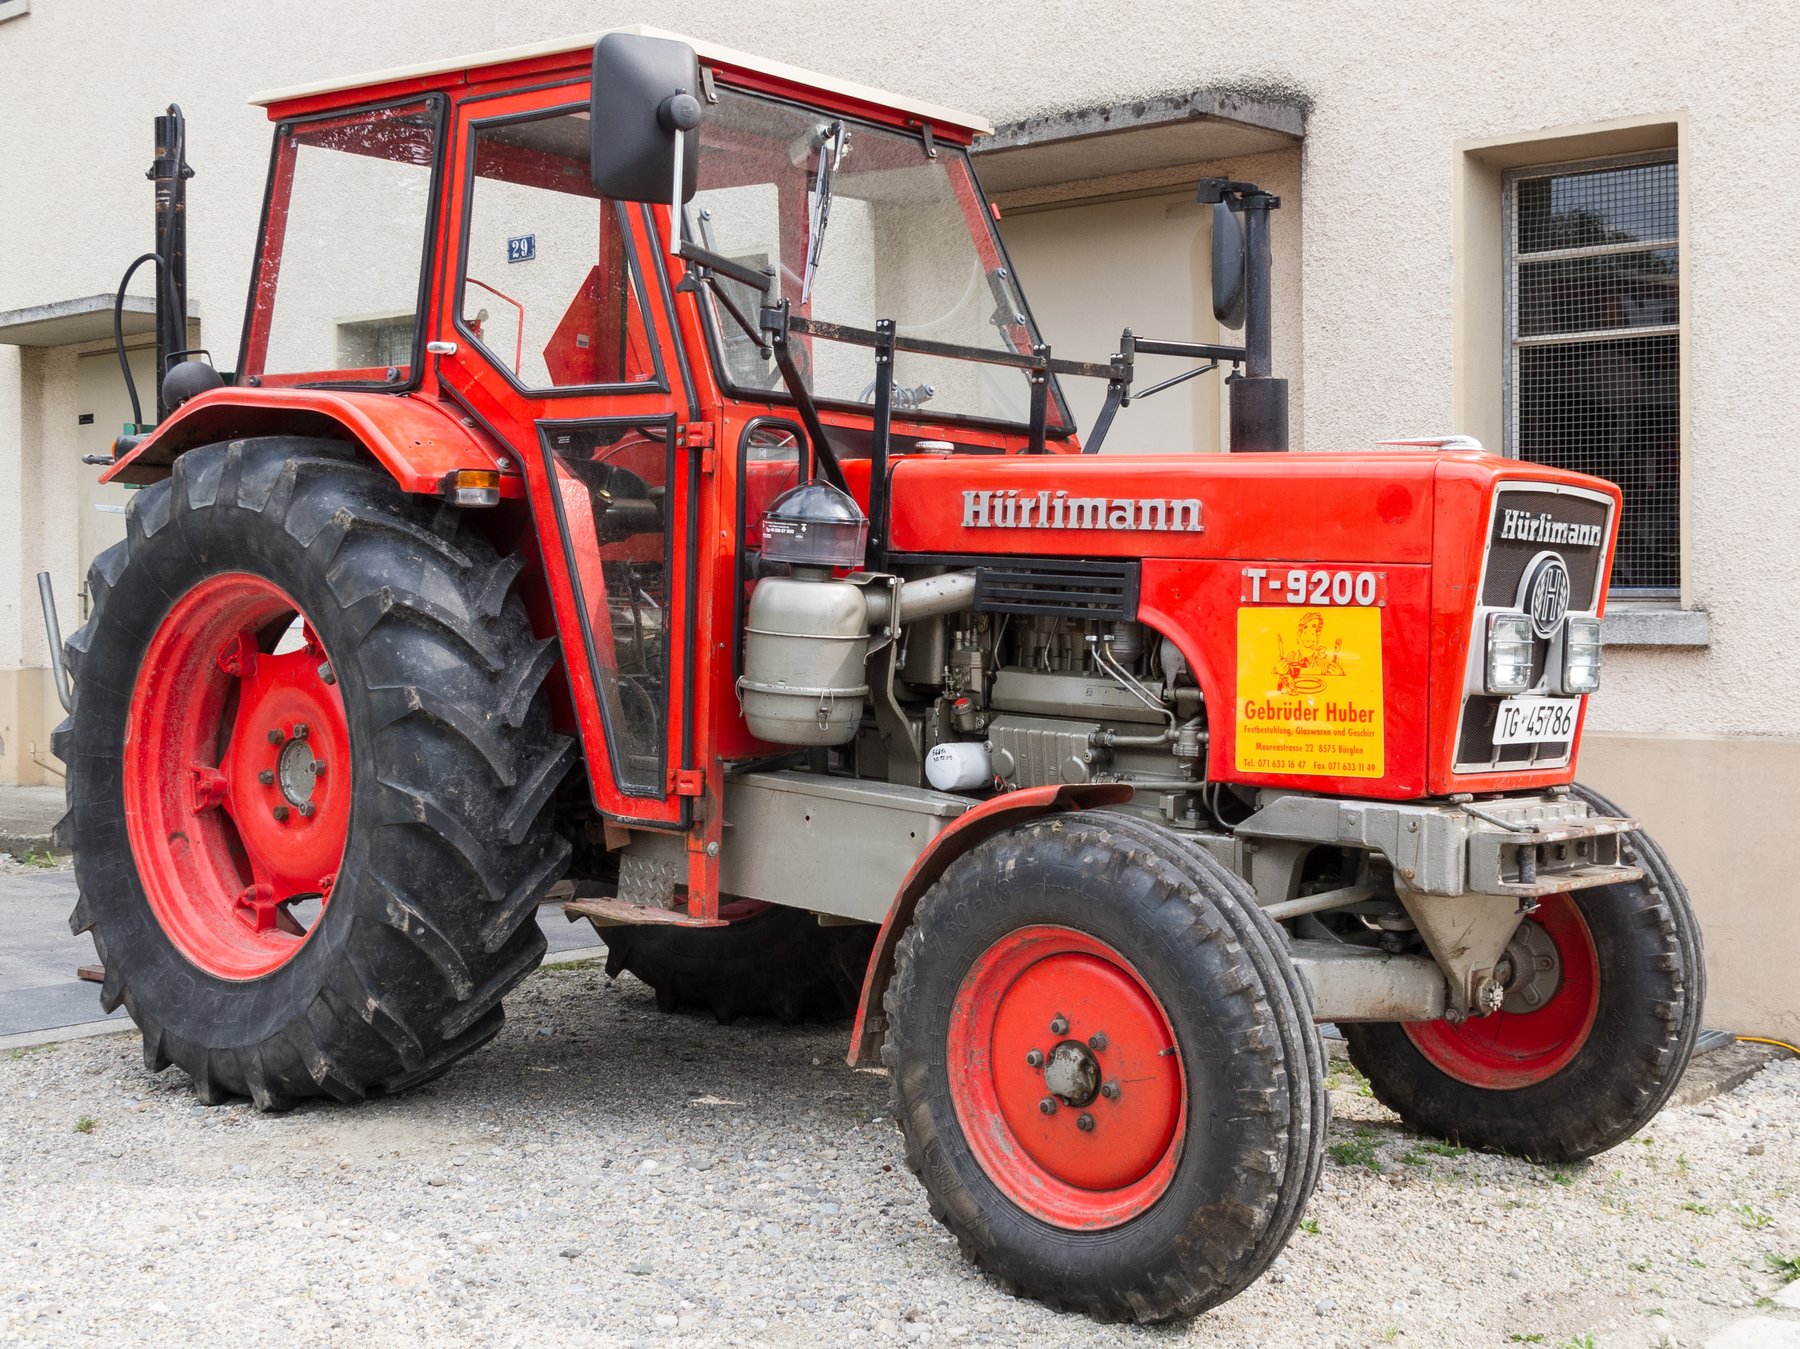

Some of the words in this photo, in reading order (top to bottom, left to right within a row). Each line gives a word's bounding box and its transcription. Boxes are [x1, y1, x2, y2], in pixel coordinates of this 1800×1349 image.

[512, 239, 528, 258] 29
[961, 489, 1204, 532] Hürlimann
[1500, 509, 1601, 547] Hürlimann
[1247, 568, 1376, 606] T-9200
[1244, 700, 1319, 722] Gebrüder
[1326, 702, 1375, 723] Huber
[1503, 707, 1520, 738] TG
[1526, 705, 1572, 737] 45786
[1244, 725, 1294, 737] Festbestuhlung,
[1295, 726, 1332, 736] Glaswaren
[1333, 728, 1346, 737] und
[1347, 728, 1375, 737] Geschirr
[1255, 742, 1303, 752] Maurenstrasse
[1305, 744, 1314, 752] 22
[1318, 744, 1336, 753] 8575
[1338, 745, 1364, 756] Bürglen
[1244, 758, 1255, 767] Tel.
[1258, 759, 1270, 768] 071
[1272, 760, 1285, 768] 633
[1288, 760, 1295, 769] 16
[1298, 761, 1306, 769] 47
[1313, 761, 1326, 770] Fax
[1328, 762, 1340, 770] 071
[1342, 762, 1356, 771] 633
[1358, 763, 1365, 771] 11
[1366, 763, 1376, 772] 49
